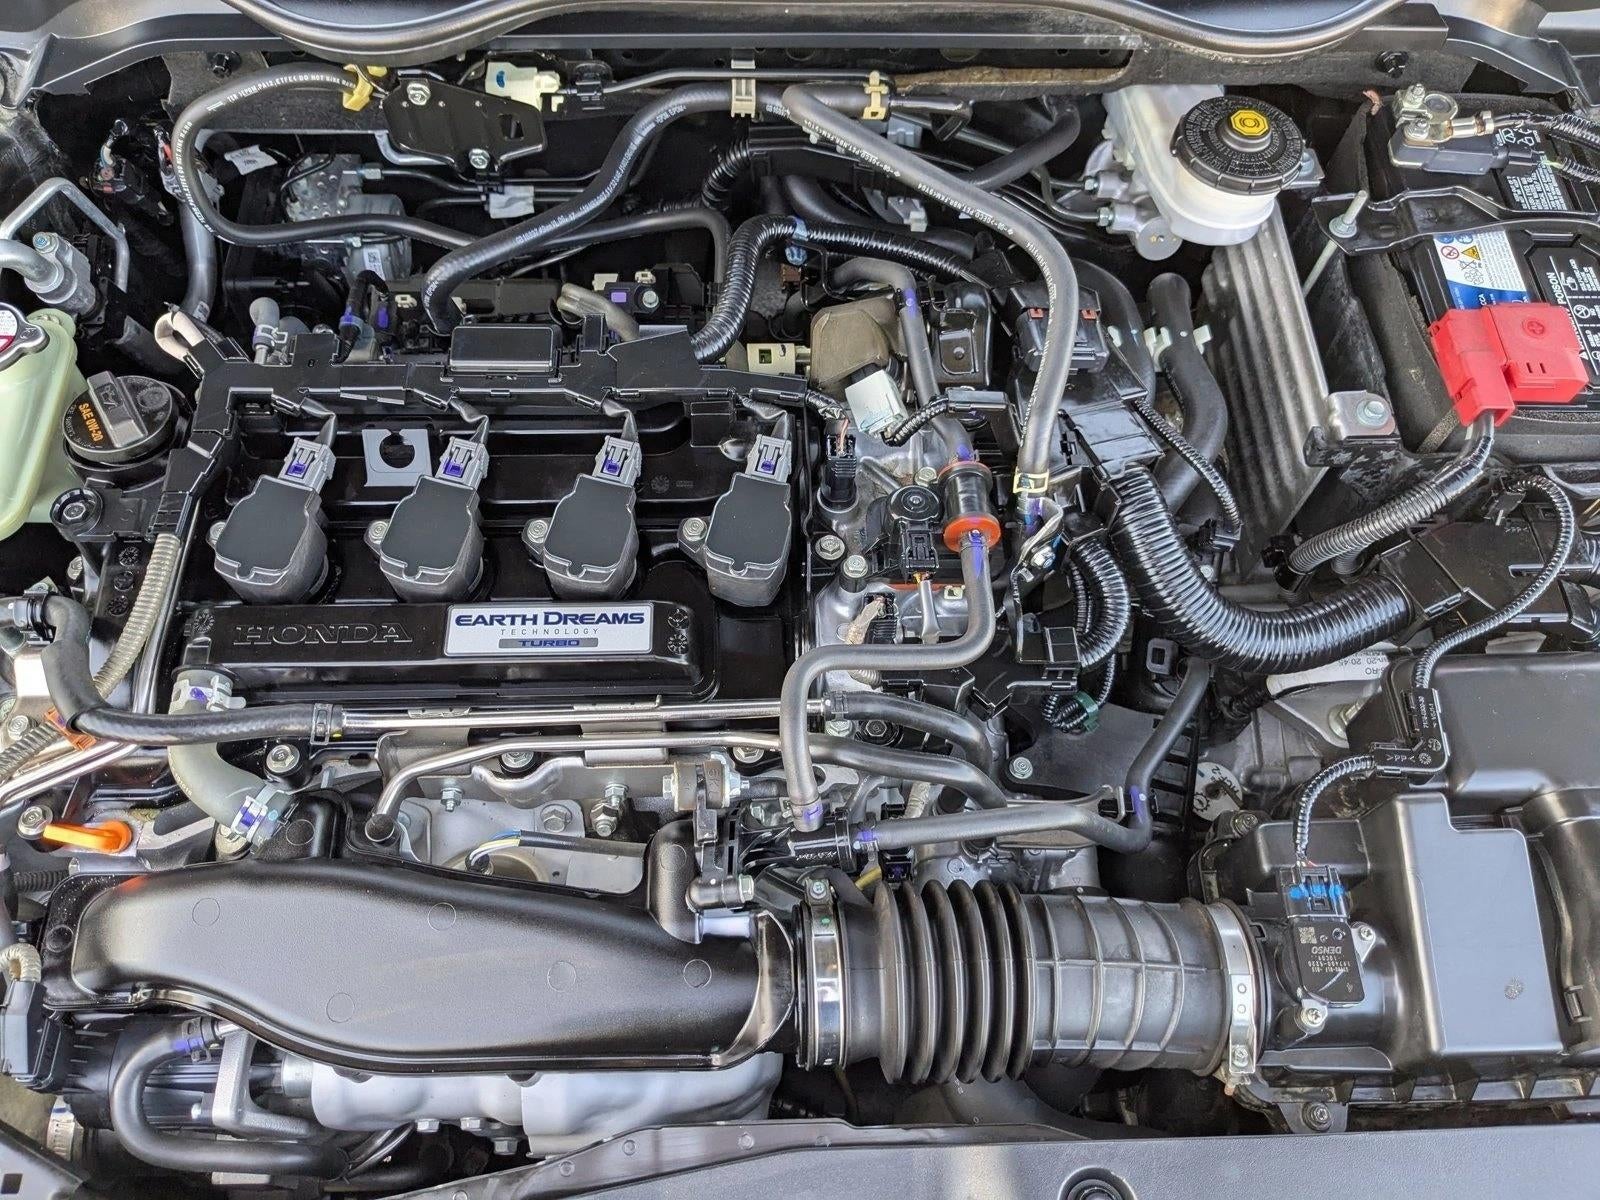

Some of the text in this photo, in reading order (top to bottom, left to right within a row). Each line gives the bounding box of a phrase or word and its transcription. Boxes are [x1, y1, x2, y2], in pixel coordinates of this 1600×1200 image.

[1546, 272, 1567, 305] POISON
[79, 403, 104, 442] SAE 0W-20
[455, 611, 645, 627] EARTH DREAMS
[233, 622, 413, 645] HONDA
[500, 628, 599, 636] TECHNOLOGY
[518, 639, 580, 648] TURBO
[1311, 946, 1342, 955] DENSO
